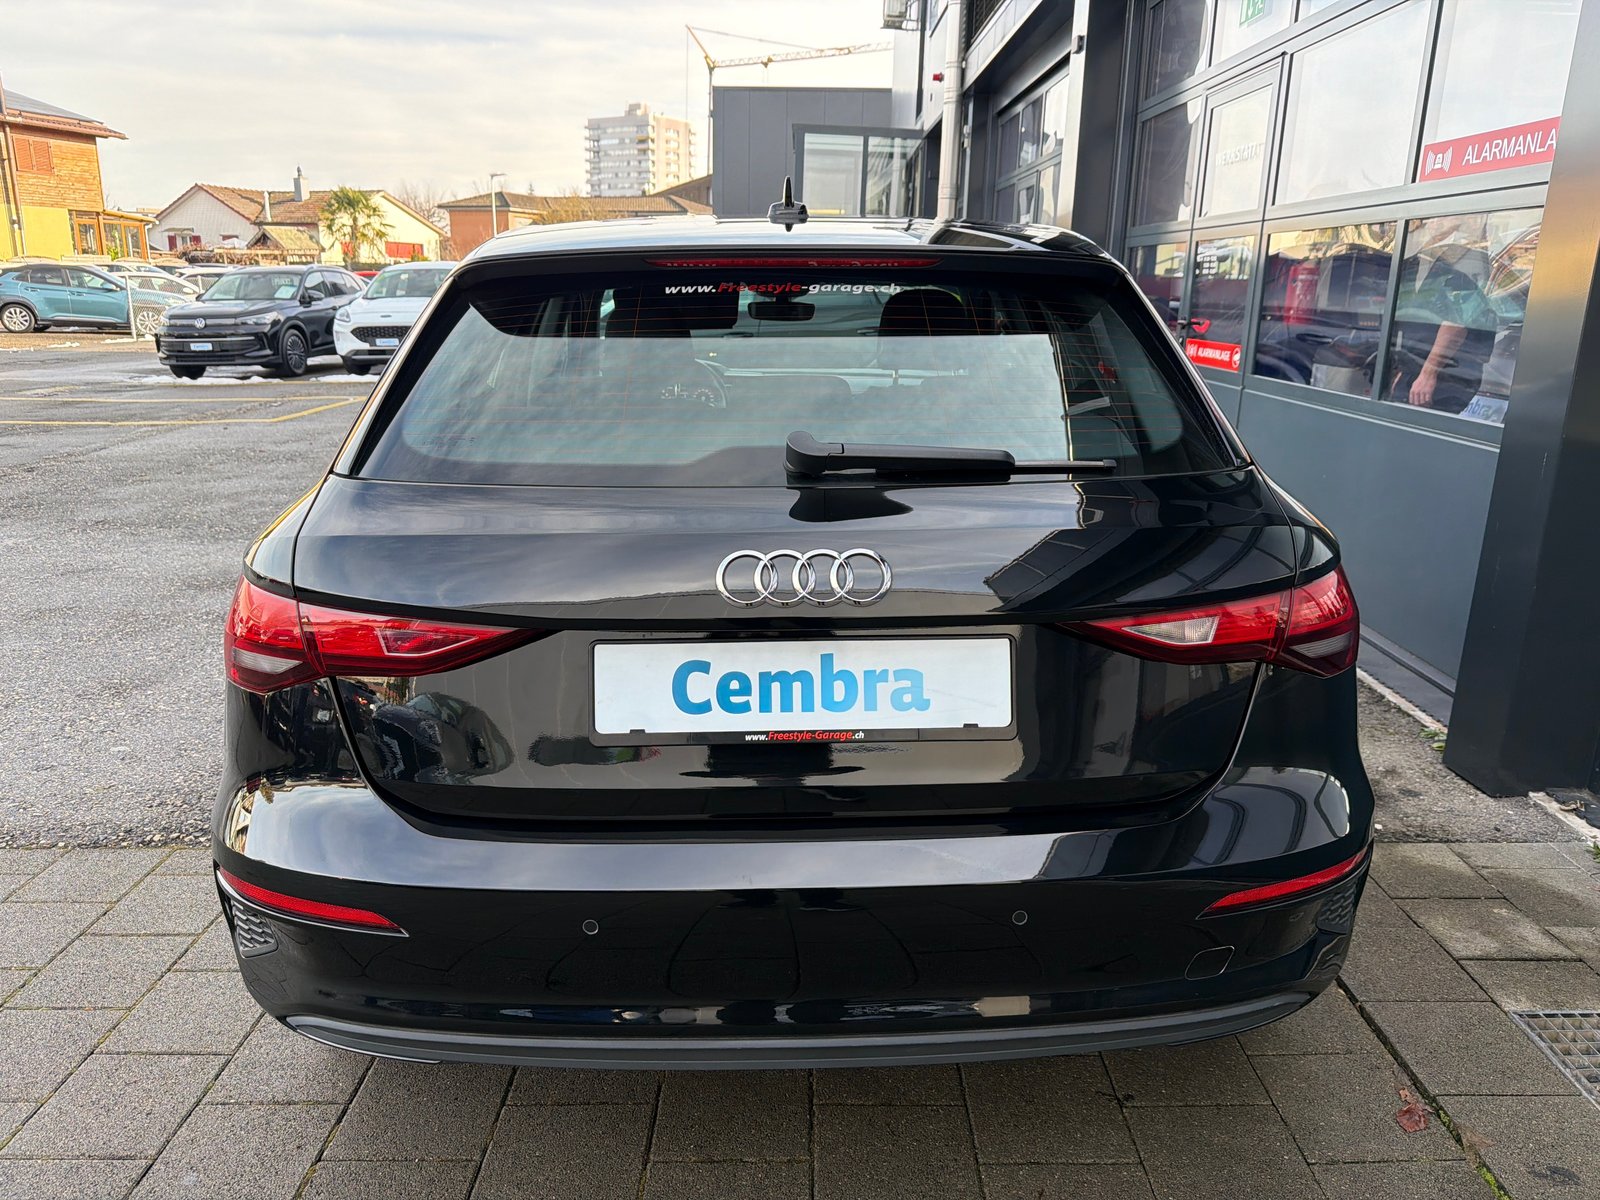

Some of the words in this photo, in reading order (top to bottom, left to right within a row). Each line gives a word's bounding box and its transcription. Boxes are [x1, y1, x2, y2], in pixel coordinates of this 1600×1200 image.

[665, 281, 901, 295] www.Freestyle-garage.ch
[1198, 347, 1231, 361] ALARMANLAGE
[672, 653, 931, 715] Cembra
[745, 730, 865, 742] www.Freestyle-Garage.ch
